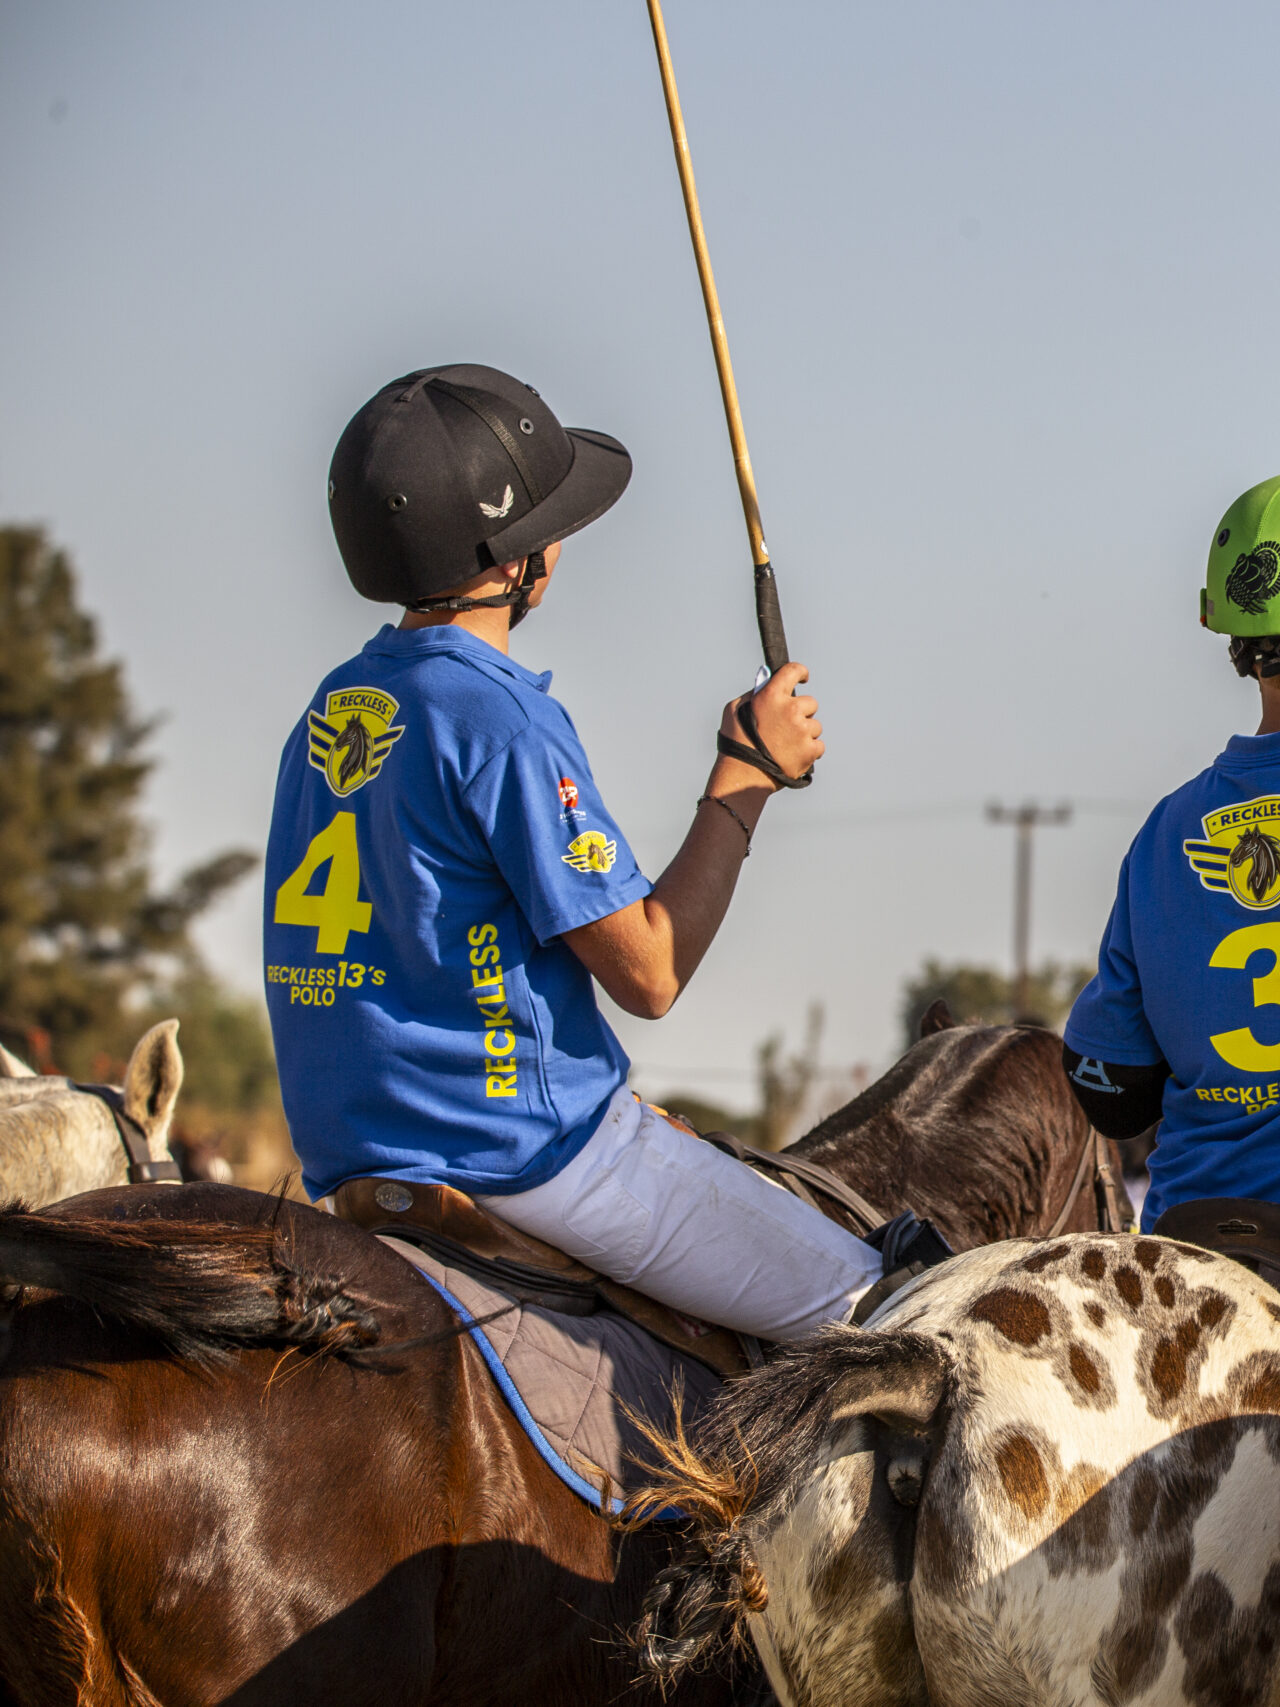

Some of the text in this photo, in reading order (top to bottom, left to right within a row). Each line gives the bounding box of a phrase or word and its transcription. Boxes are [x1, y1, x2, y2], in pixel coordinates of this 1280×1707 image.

[339, 694, 389, 715] RECKLESS
[274, 811, 373, 954] 4
[267, 965, 336, 987] RECKLESS
[290, 985, 336, 1007] POLO
[468, 923, 518, 1097] RECKLESS
